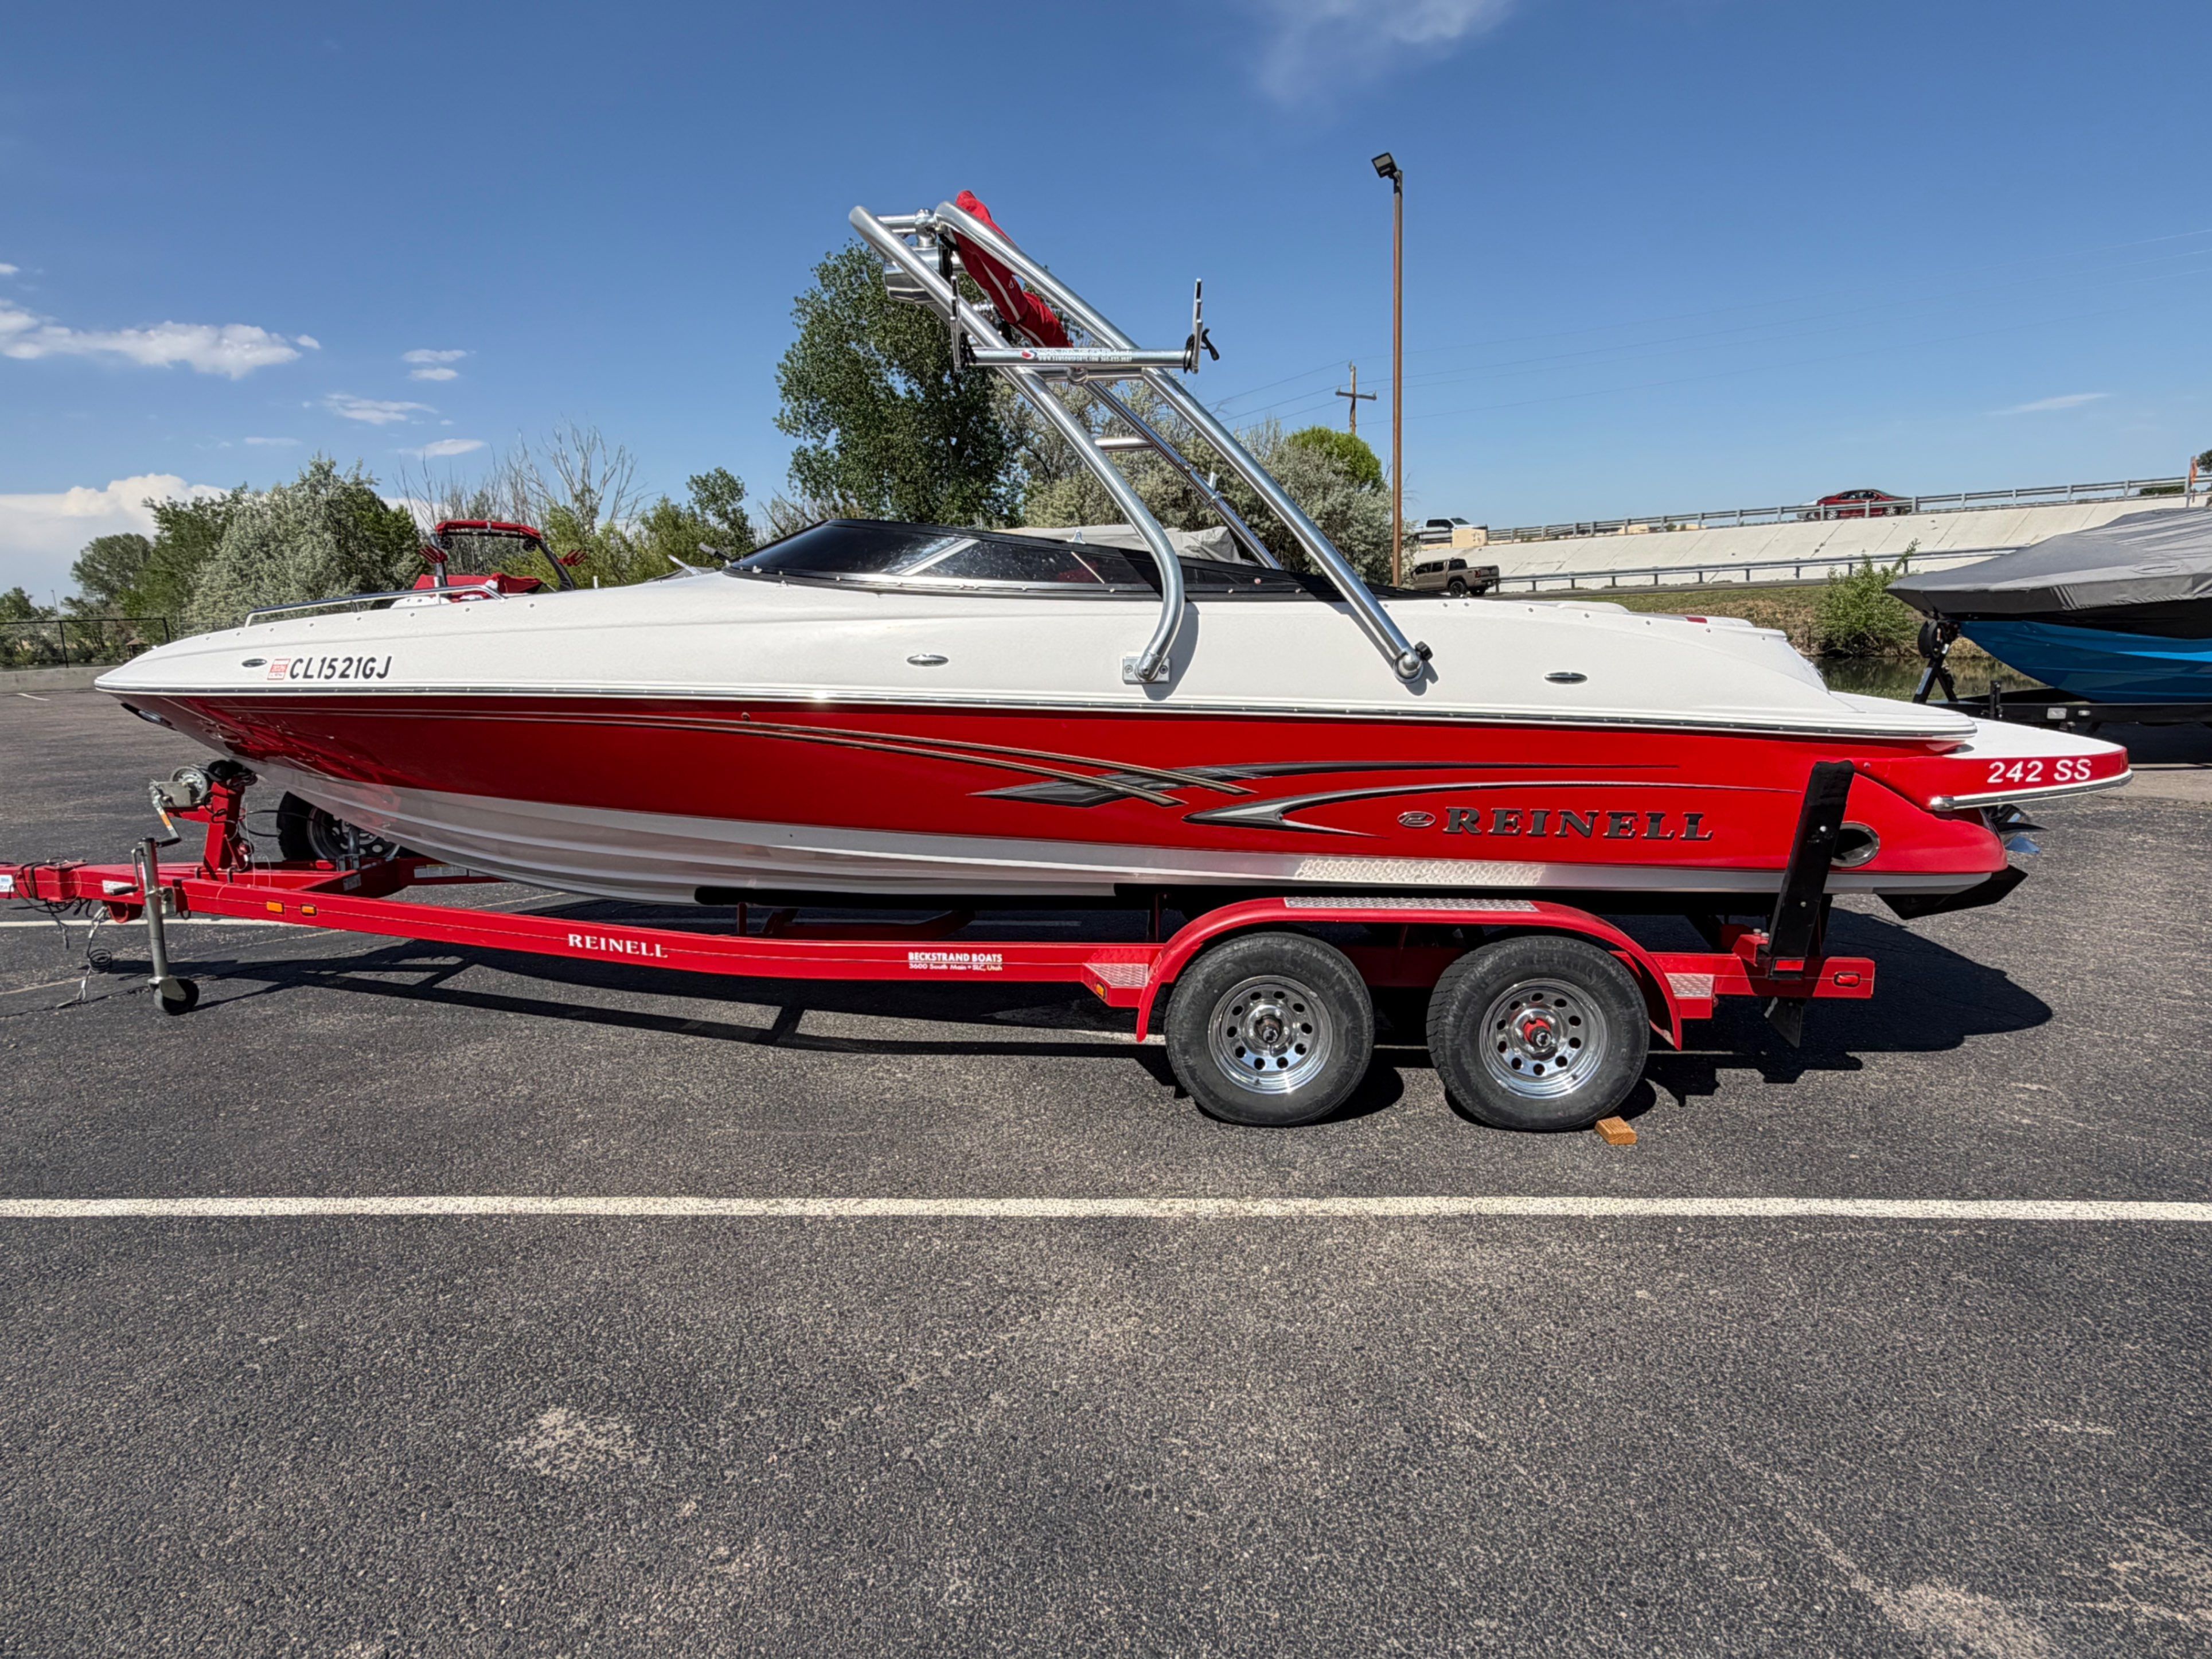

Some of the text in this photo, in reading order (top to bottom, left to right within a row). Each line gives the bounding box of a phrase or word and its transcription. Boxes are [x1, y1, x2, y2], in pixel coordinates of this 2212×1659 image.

[290, 656, 392, 680] CL1521GJ
[1987, 758, 2092, 784] 242 SS
[1442, 806, 1714, 841] REINELL
[567, 933, 669, 959] REINELL
[908, 952, 1003, 963] BECKSTRAND BOATS
